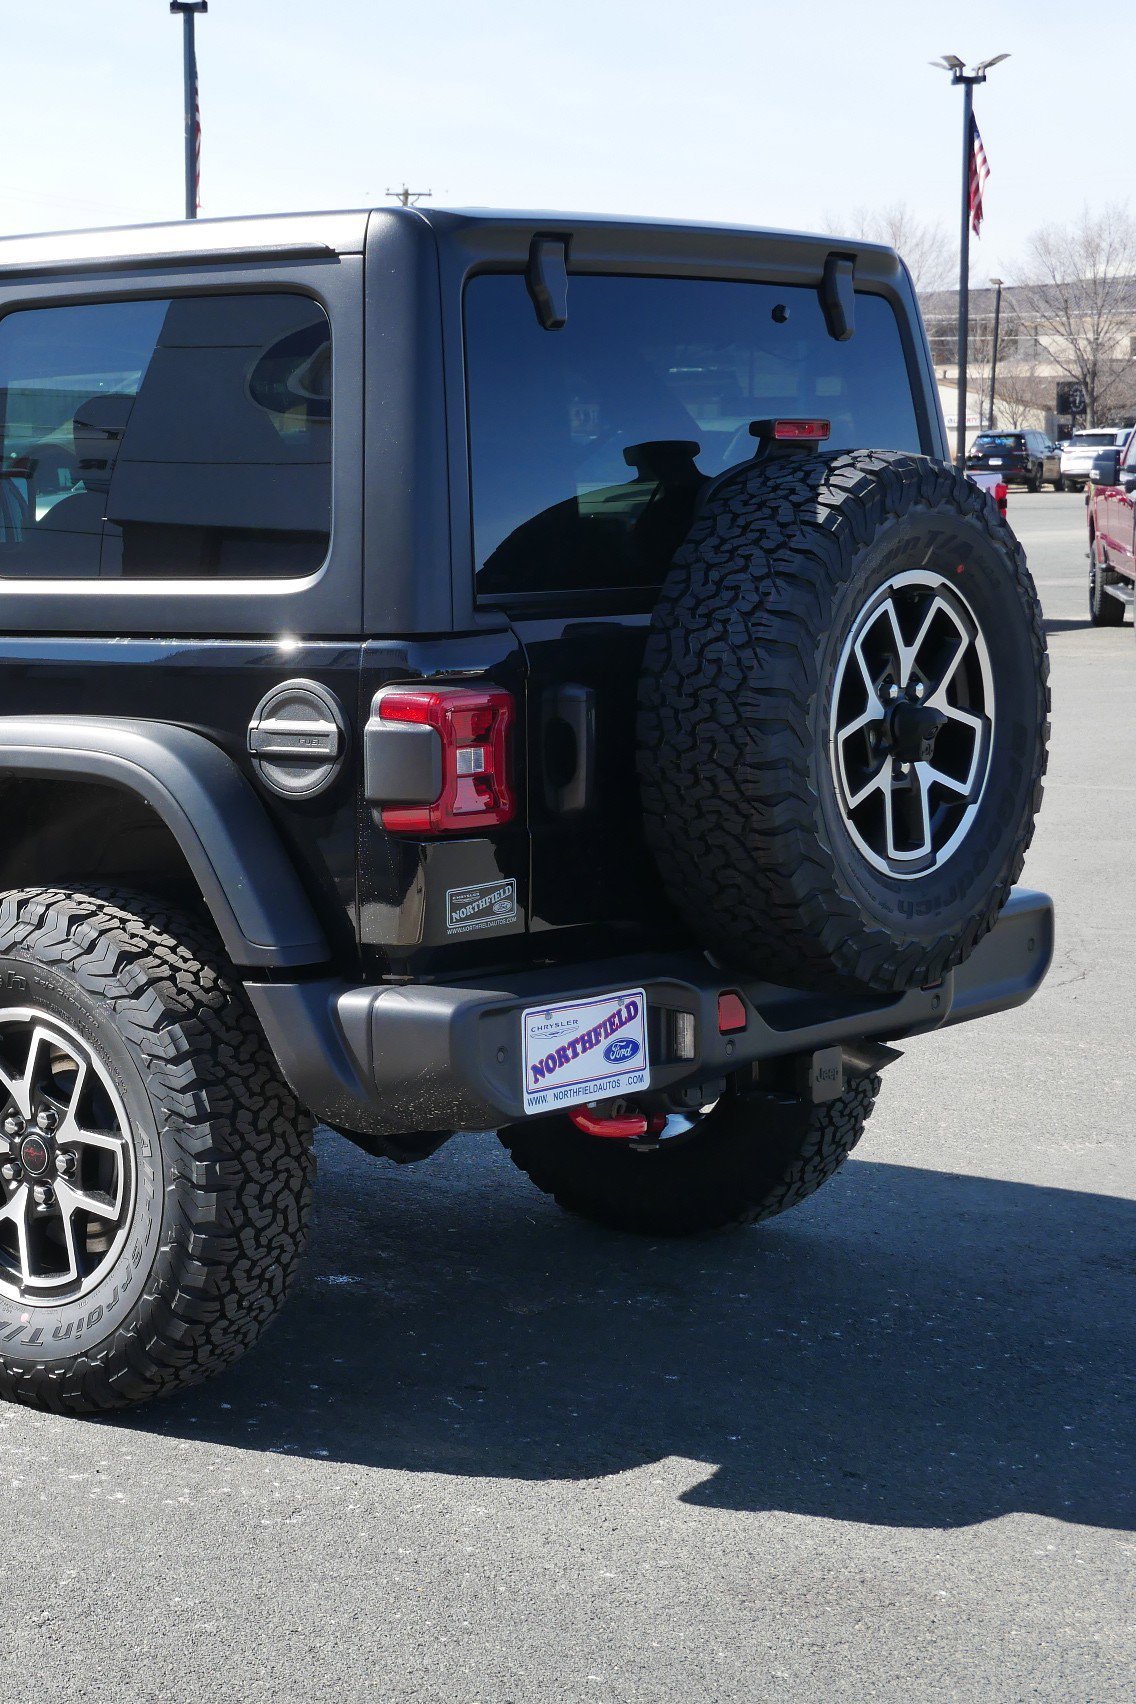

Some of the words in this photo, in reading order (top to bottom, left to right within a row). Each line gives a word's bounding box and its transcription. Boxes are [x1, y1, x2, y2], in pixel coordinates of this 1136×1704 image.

[451, 885, 513, 923] NORTHFIELD
[530, 1018, 579, 1033] CHRYSLER
[530, 999, 639, 1085] NORTHFIELD
[609, 1041, 633, 1060] Ford
[553, 1078, 621, 1102] NORTHFIELDAUTOS
